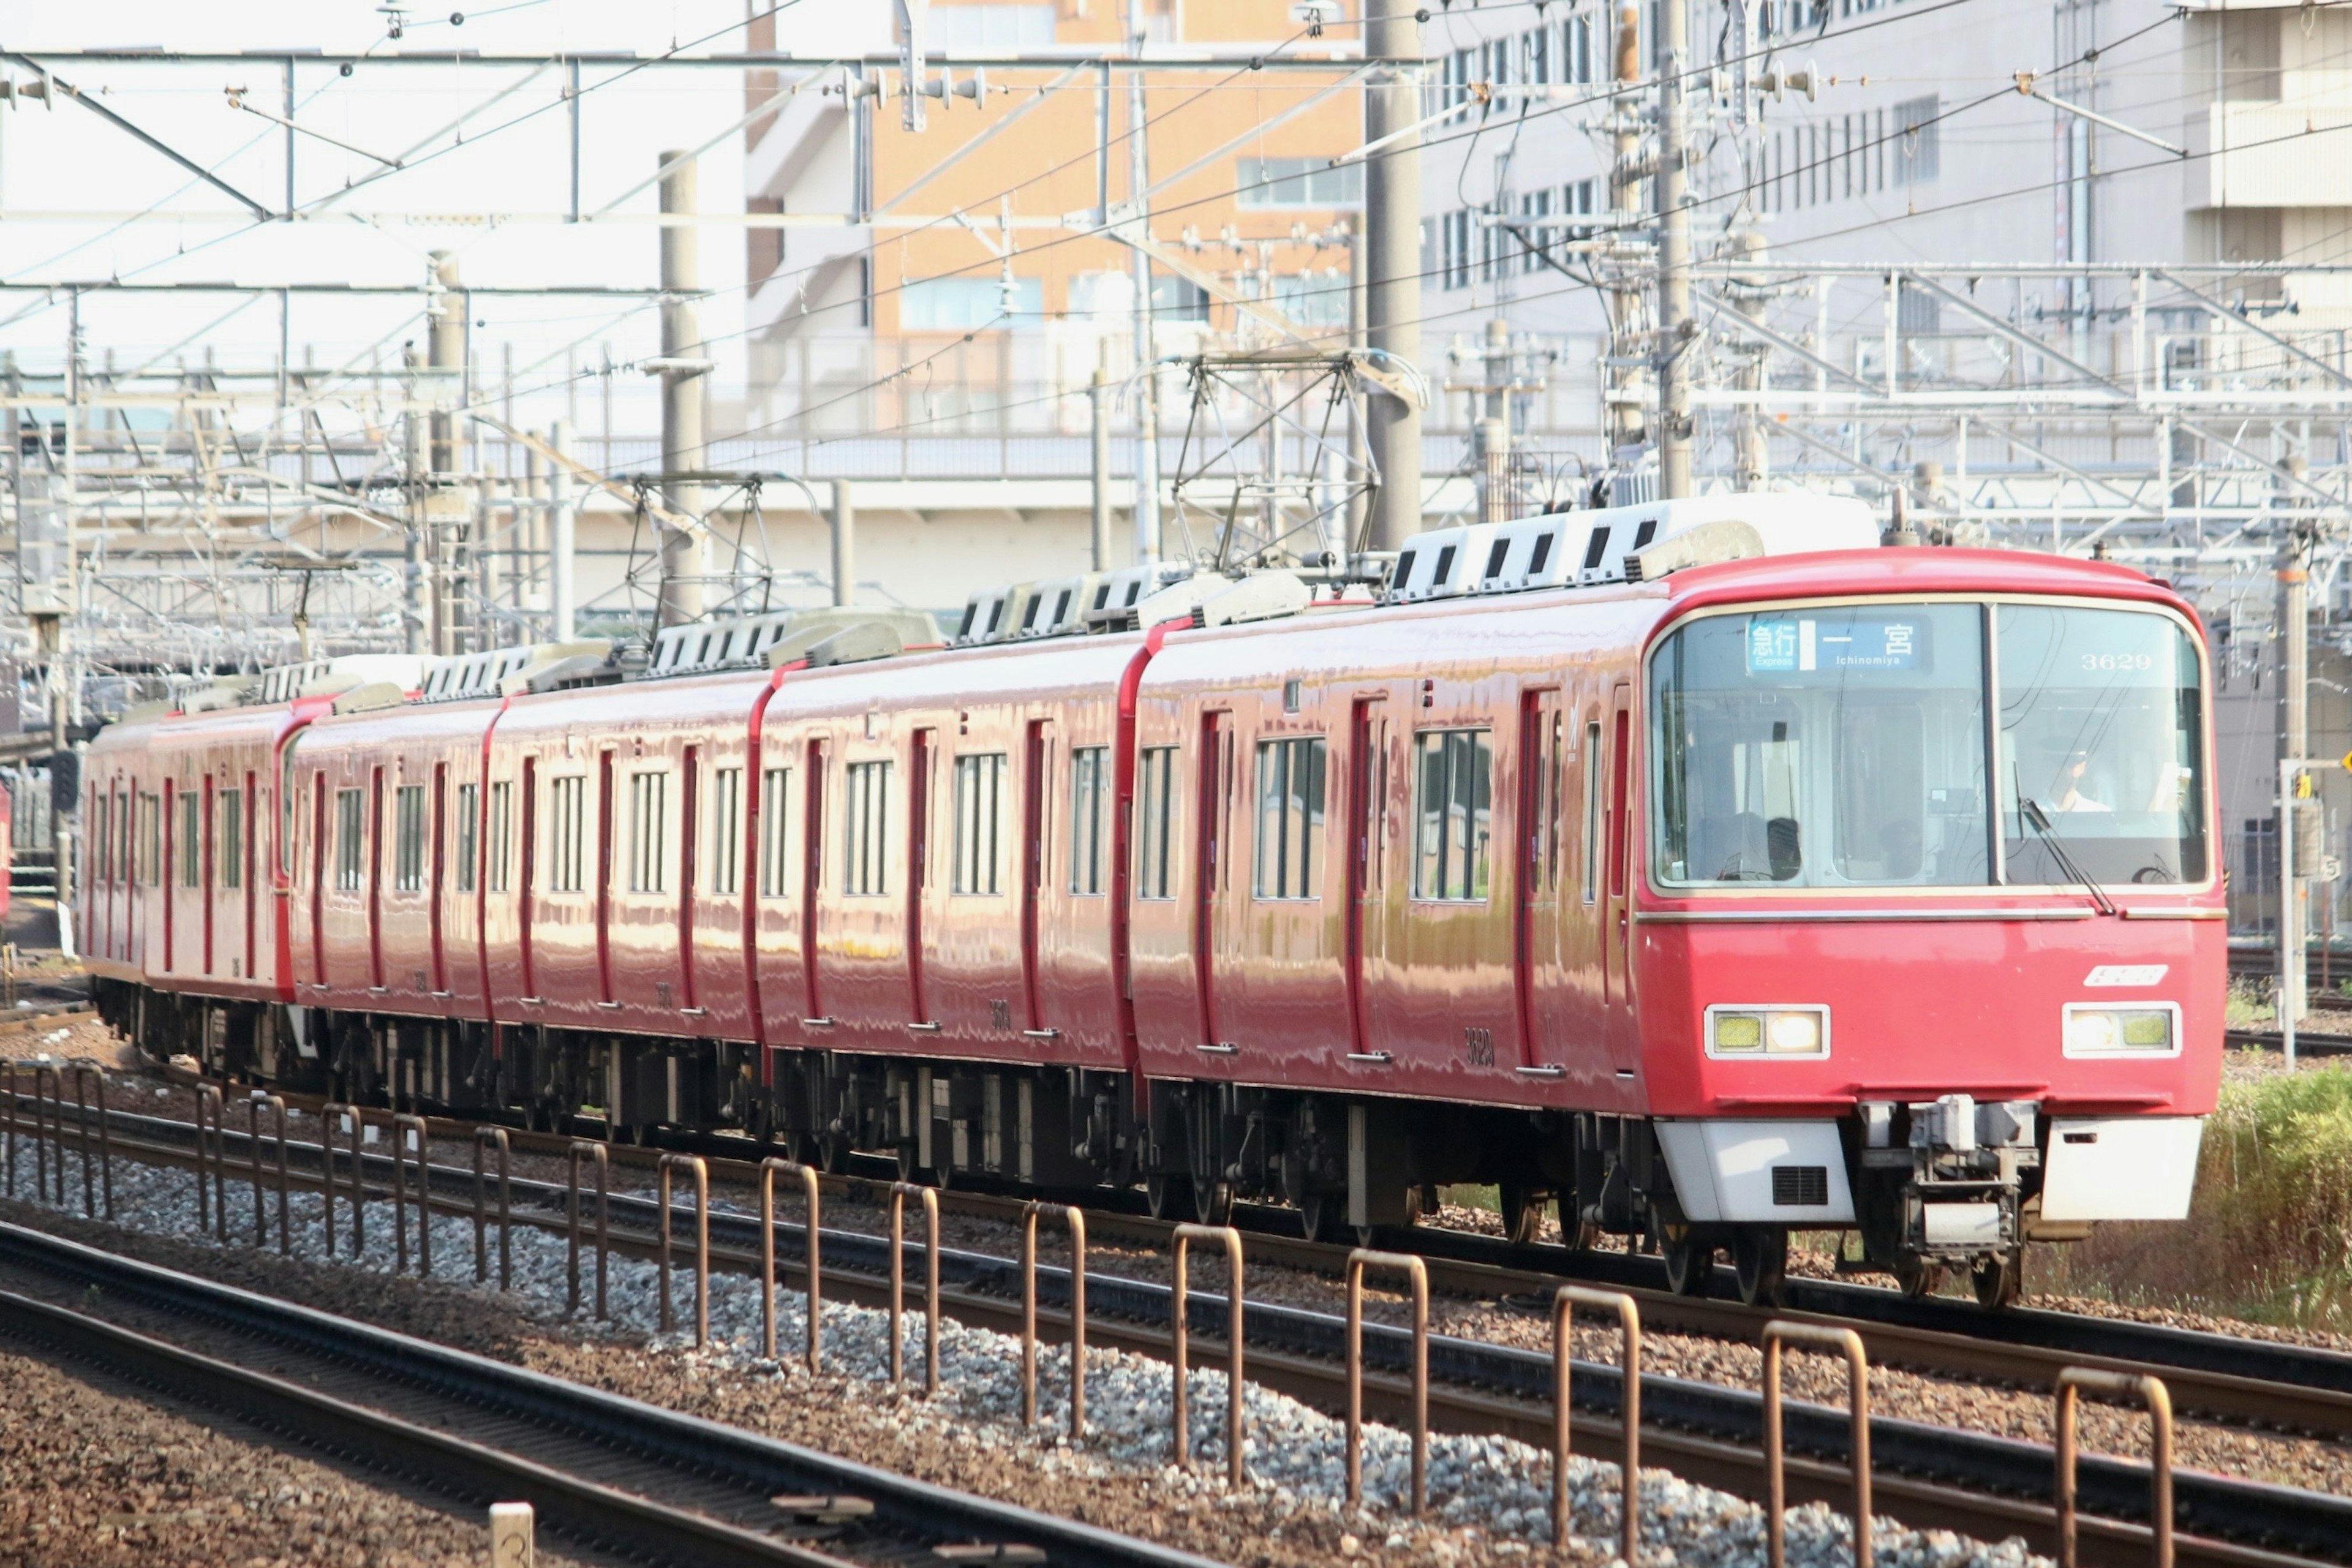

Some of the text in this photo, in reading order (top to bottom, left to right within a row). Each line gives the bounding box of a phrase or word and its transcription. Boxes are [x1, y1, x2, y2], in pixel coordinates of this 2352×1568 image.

[1752, 625, 1796, 657] 急行
[1755, 657, 1793, 667] Express
[1836, 655, 1900, 666] Ichinomiya
[2081, 654, 2152, 670] 3629
